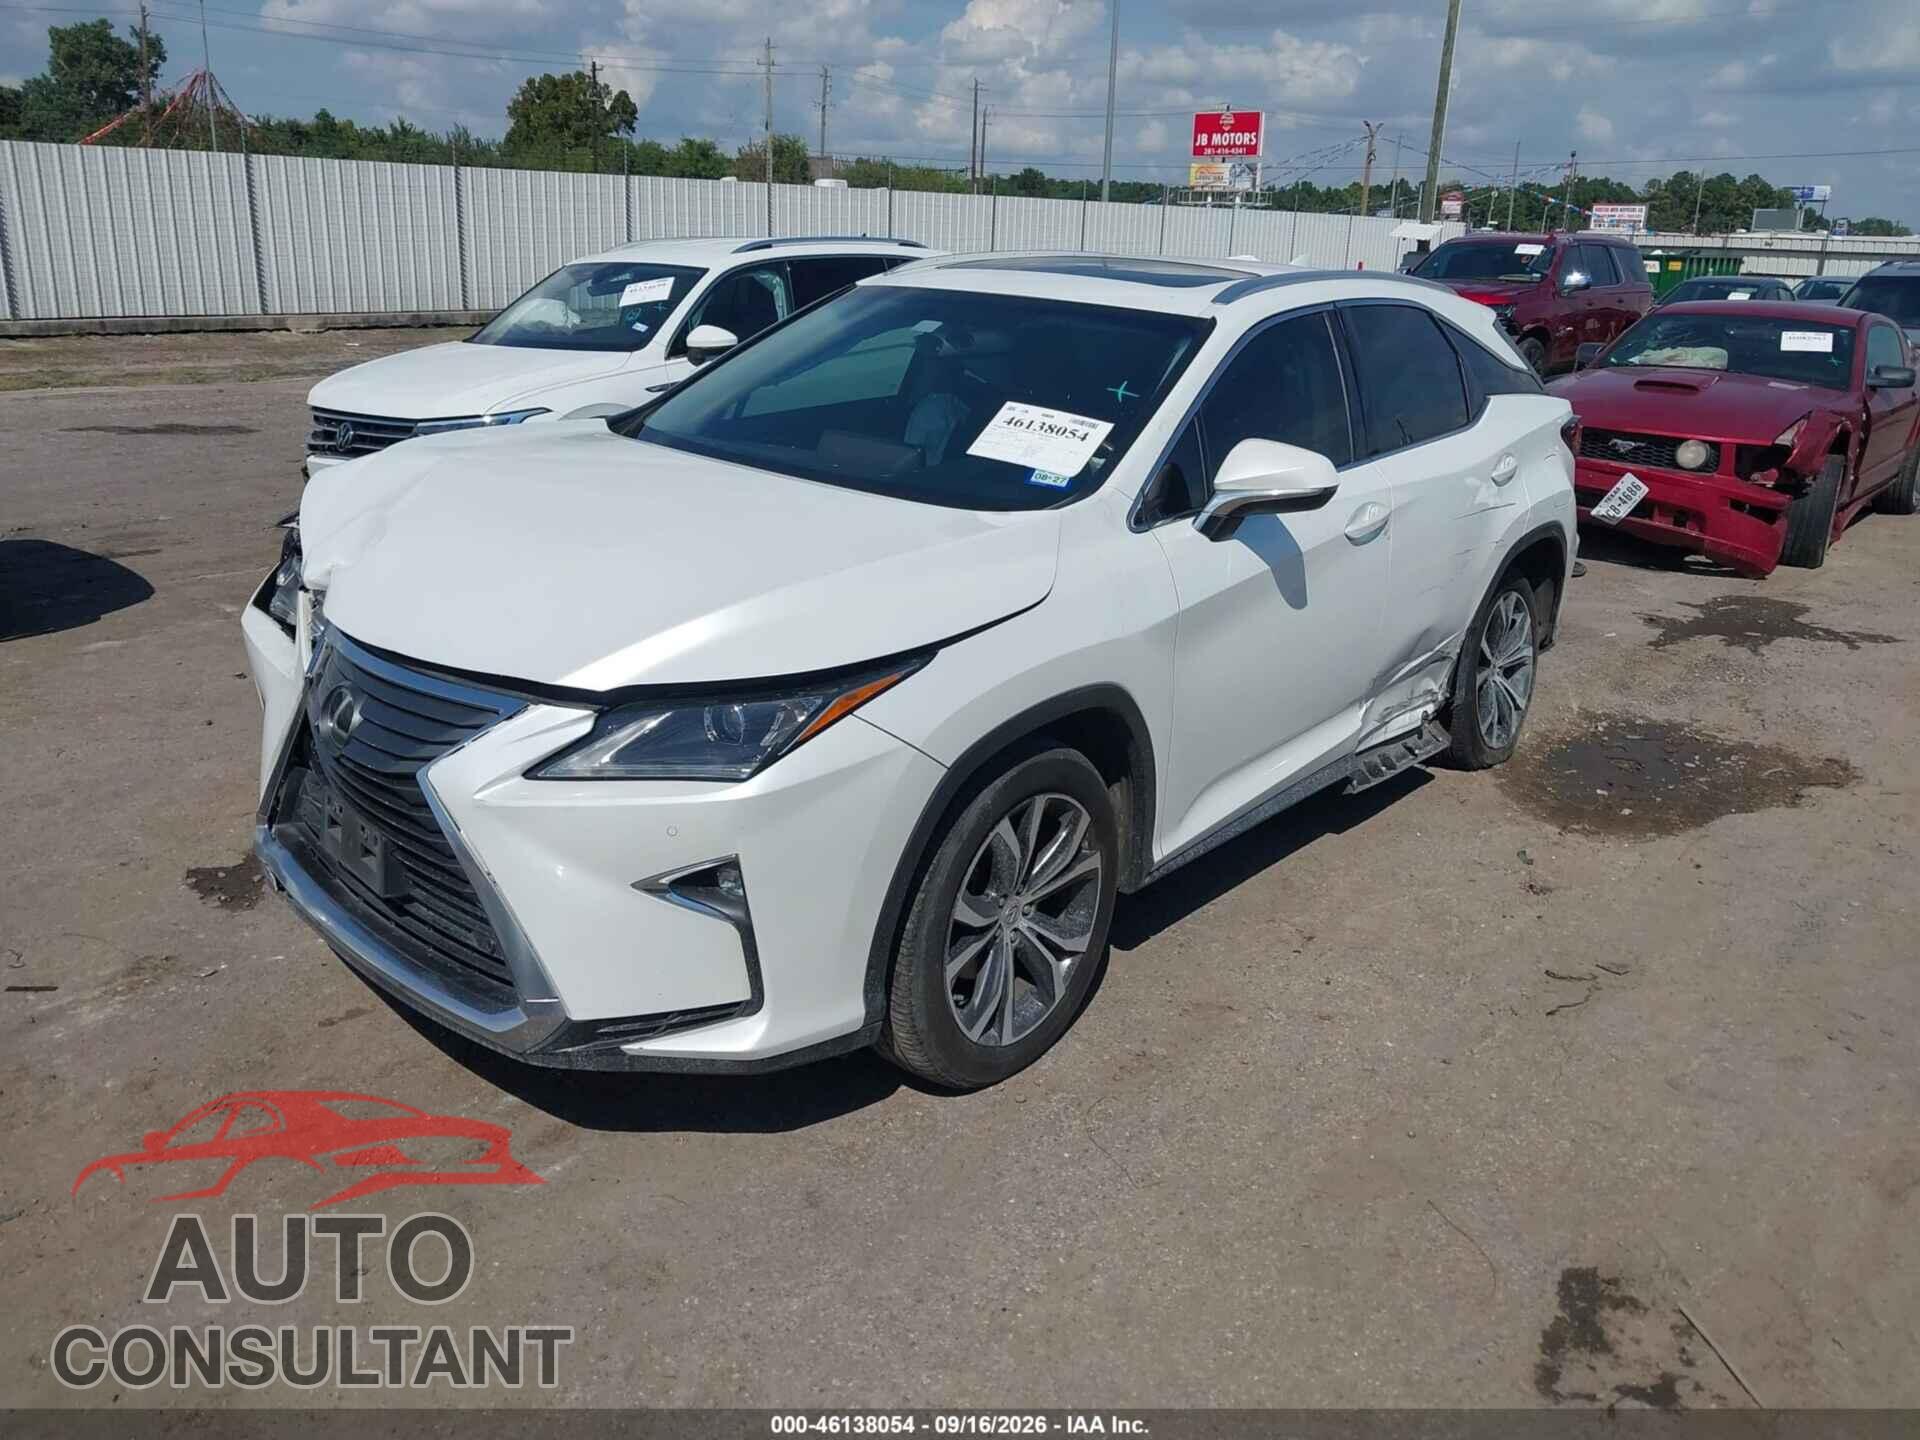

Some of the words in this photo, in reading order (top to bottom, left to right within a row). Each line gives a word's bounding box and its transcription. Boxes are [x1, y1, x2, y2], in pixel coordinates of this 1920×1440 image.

[1195, 133, 1208, 146] JB
[1211, 132, 1257, 146] MOTORS
[1003, 415, 1090, 442] 46138054
[1034, 471, 1067, 484] 08-27
